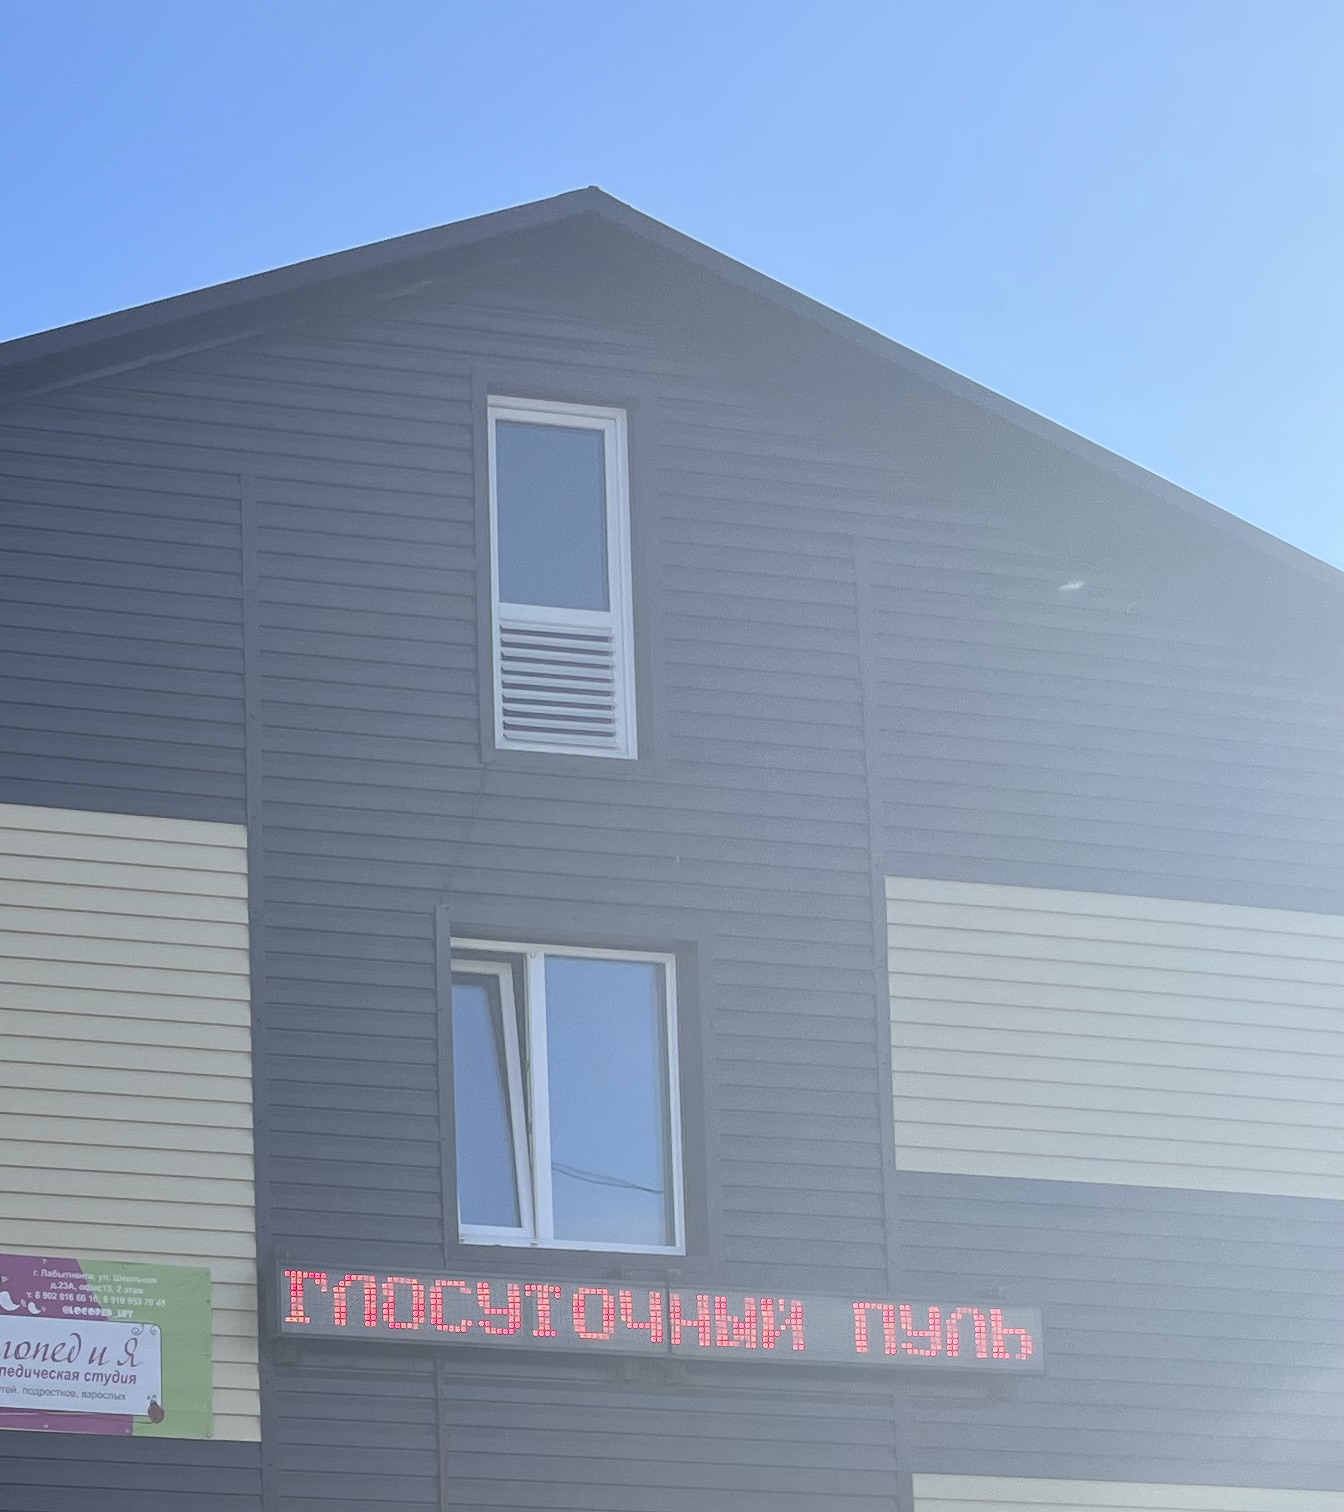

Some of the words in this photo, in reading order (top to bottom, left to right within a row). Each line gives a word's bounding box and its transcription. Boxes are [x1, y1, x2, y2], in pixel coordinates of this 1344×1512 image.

[35, 1291, 40, 1299] 8
[89, 1346, 110, 1366] и
[117, 1338, 144, 1367] Я
[84, 1370, 136, 1386] студия
